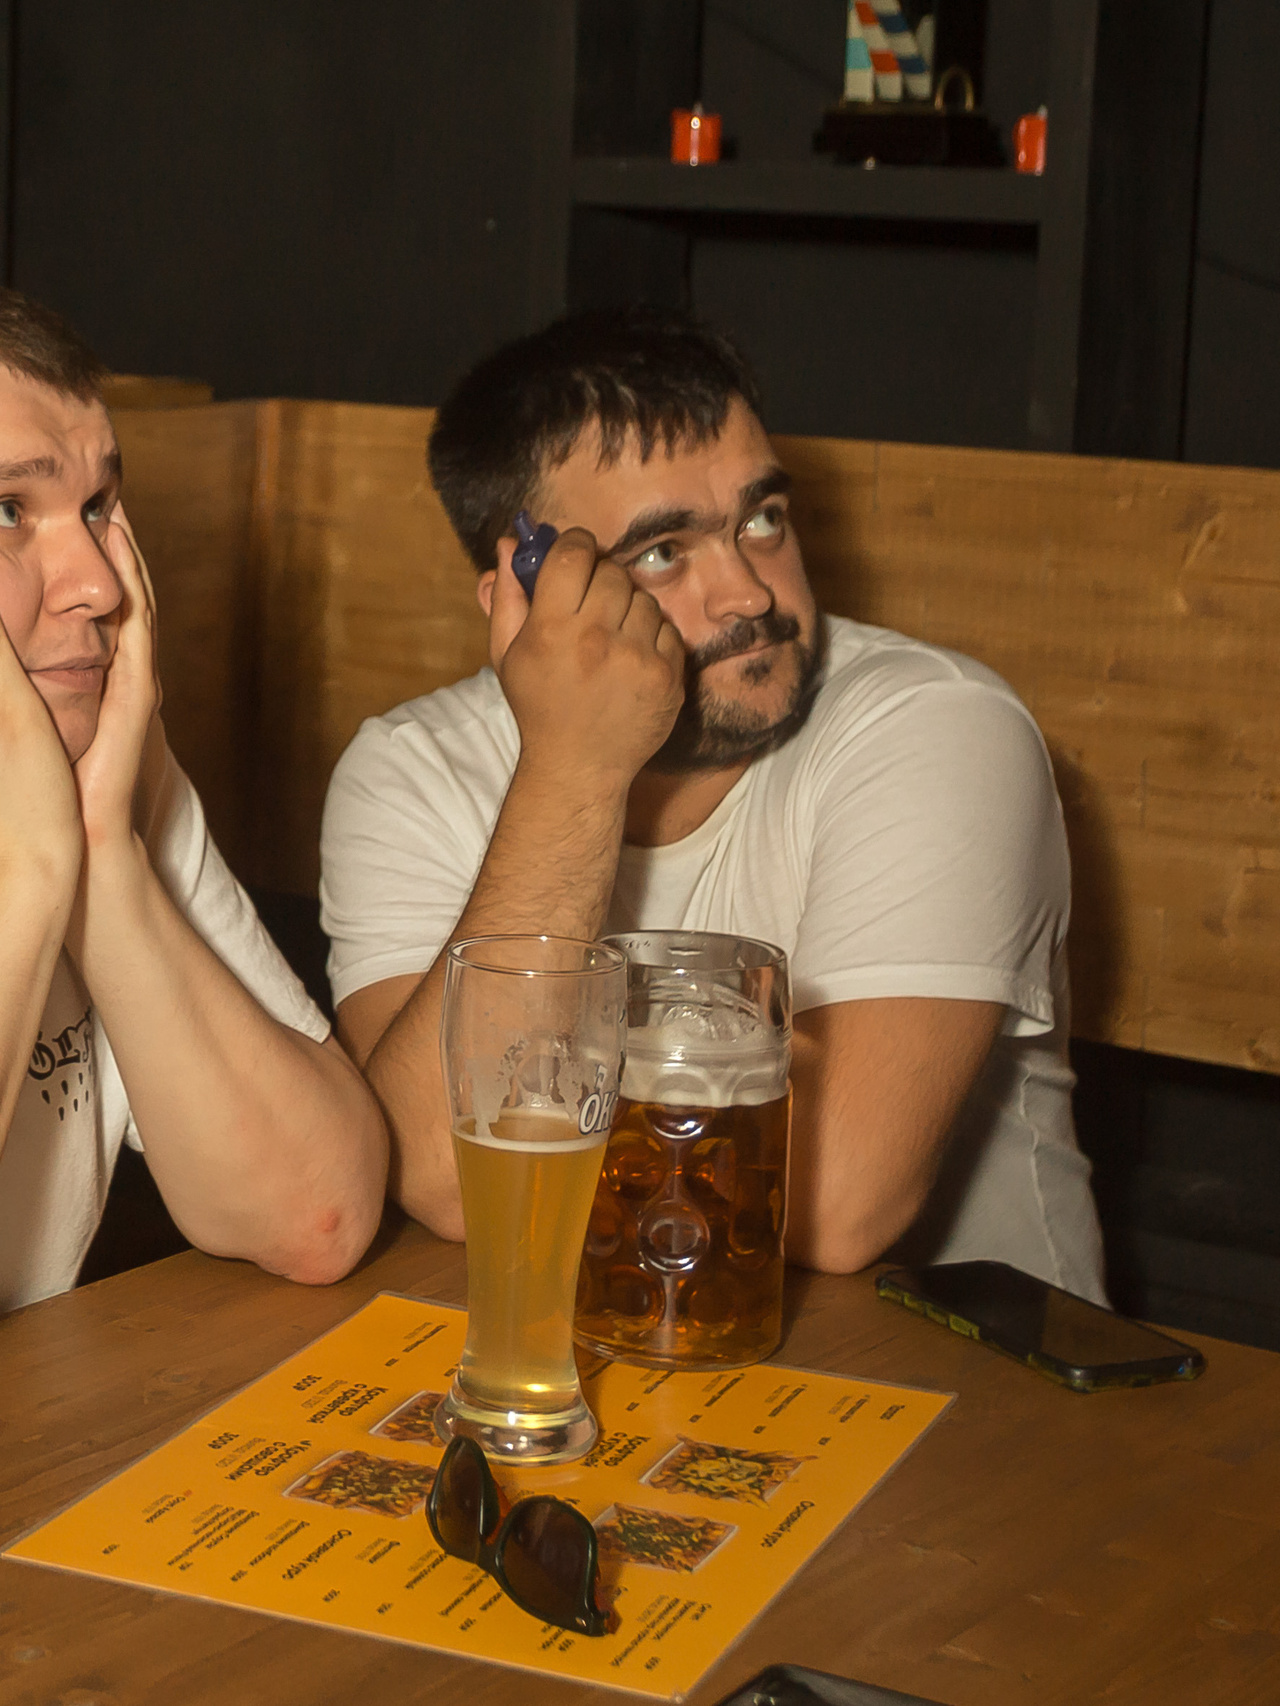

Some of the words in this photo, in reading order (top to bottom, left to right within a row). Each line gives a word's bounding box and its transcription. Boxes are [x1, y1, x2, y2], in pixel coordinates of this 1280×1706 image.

[306, 1388, 366, 1423] креветкой
[338, 1387, 389, 1416] Крафтер
[224, 1446, 279, 1480] овощами
[255, 1445, 308, 1476] Крафтер
[602, 1436, 651, 1467] Крафтер
